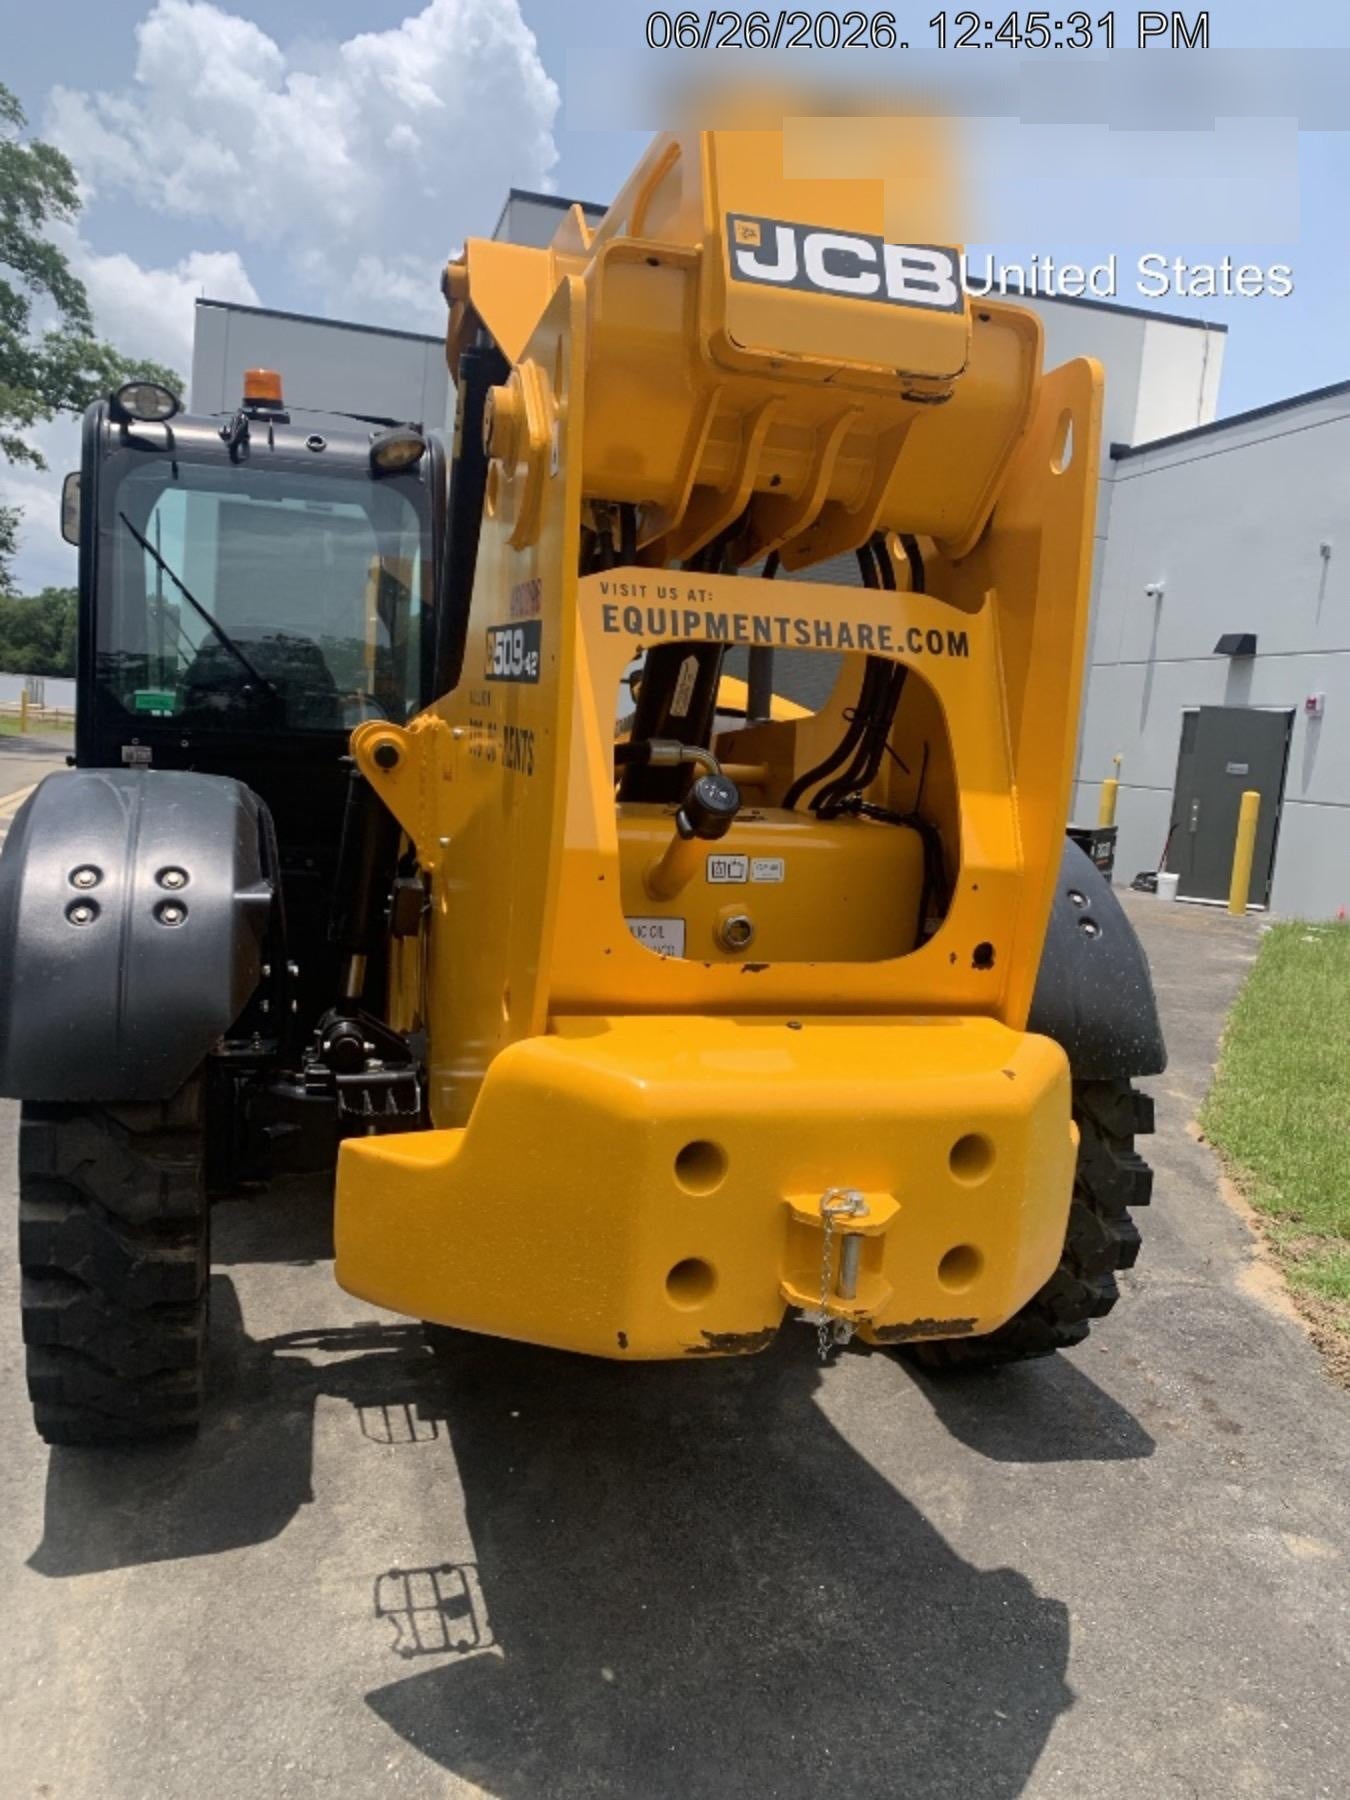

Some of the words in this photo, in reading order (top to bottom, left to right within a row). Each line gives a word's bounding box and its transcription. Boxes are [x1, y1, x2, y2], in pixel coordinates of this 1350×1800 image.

[735, 226, 958, 306] JCB
[600, 581, 647, 598] VISIT
[657, 586, 678, 600] US
[687, 589, 713, 602] AT:
[602, 603, 969, 657] EQUIPMENTSHARE.COM
